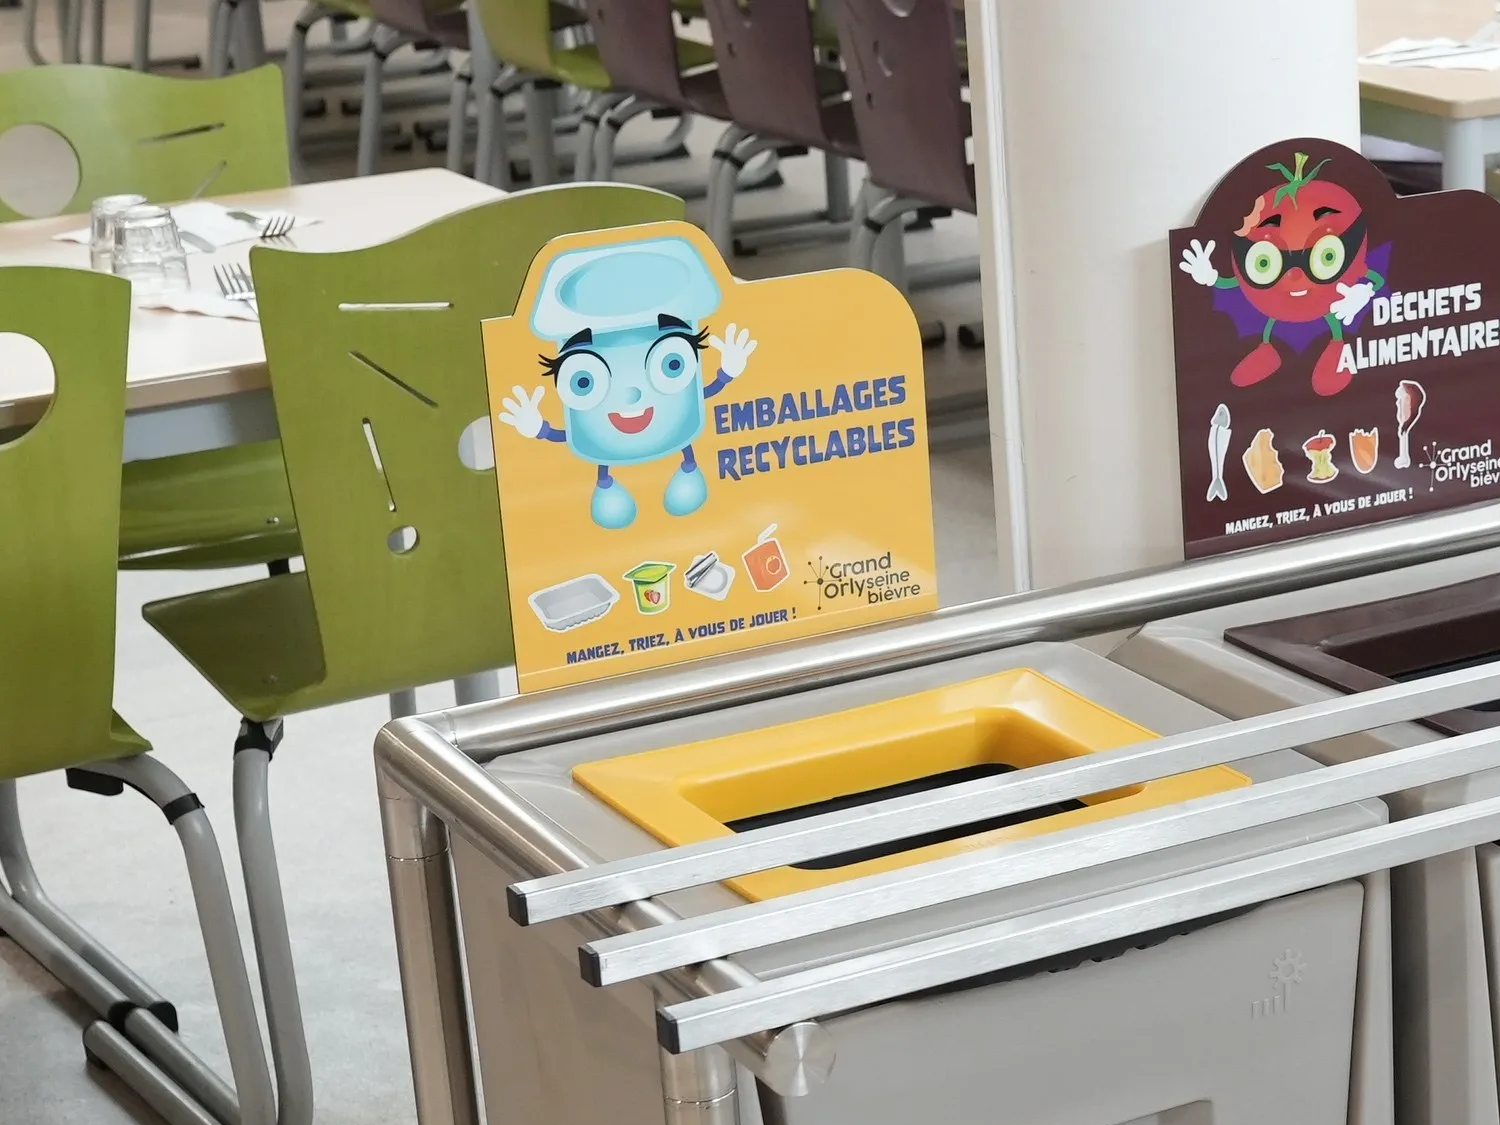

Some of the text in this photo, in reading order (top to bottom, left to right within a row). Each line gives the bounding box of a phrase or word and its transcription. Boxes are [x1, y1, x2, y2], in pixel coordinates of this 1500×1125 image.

[1372, 282, 1482, 326] DÉCHETS
[713, 375, 906, 434] EMBALLAGES
[717, 418, 915, 481] RECYCLABLES
[1440, 439, 1492, 463] Grand
[1225, 515, 1274, 535] MANGEZ,
[1275, 508, 1310, 525] TRIEZ,
[1324, 498, 1355, 515] VOUS
[1357, 495, 1371, 509] DE
[1373, 488, 1407, 506] JOUER
[829, 551, 892, 579] Grand
[867, 583, 921, 605] bièvre
[566, 606, 797, 665] MANGEZ, TRIEZ, À VOUS DE JOUER !
